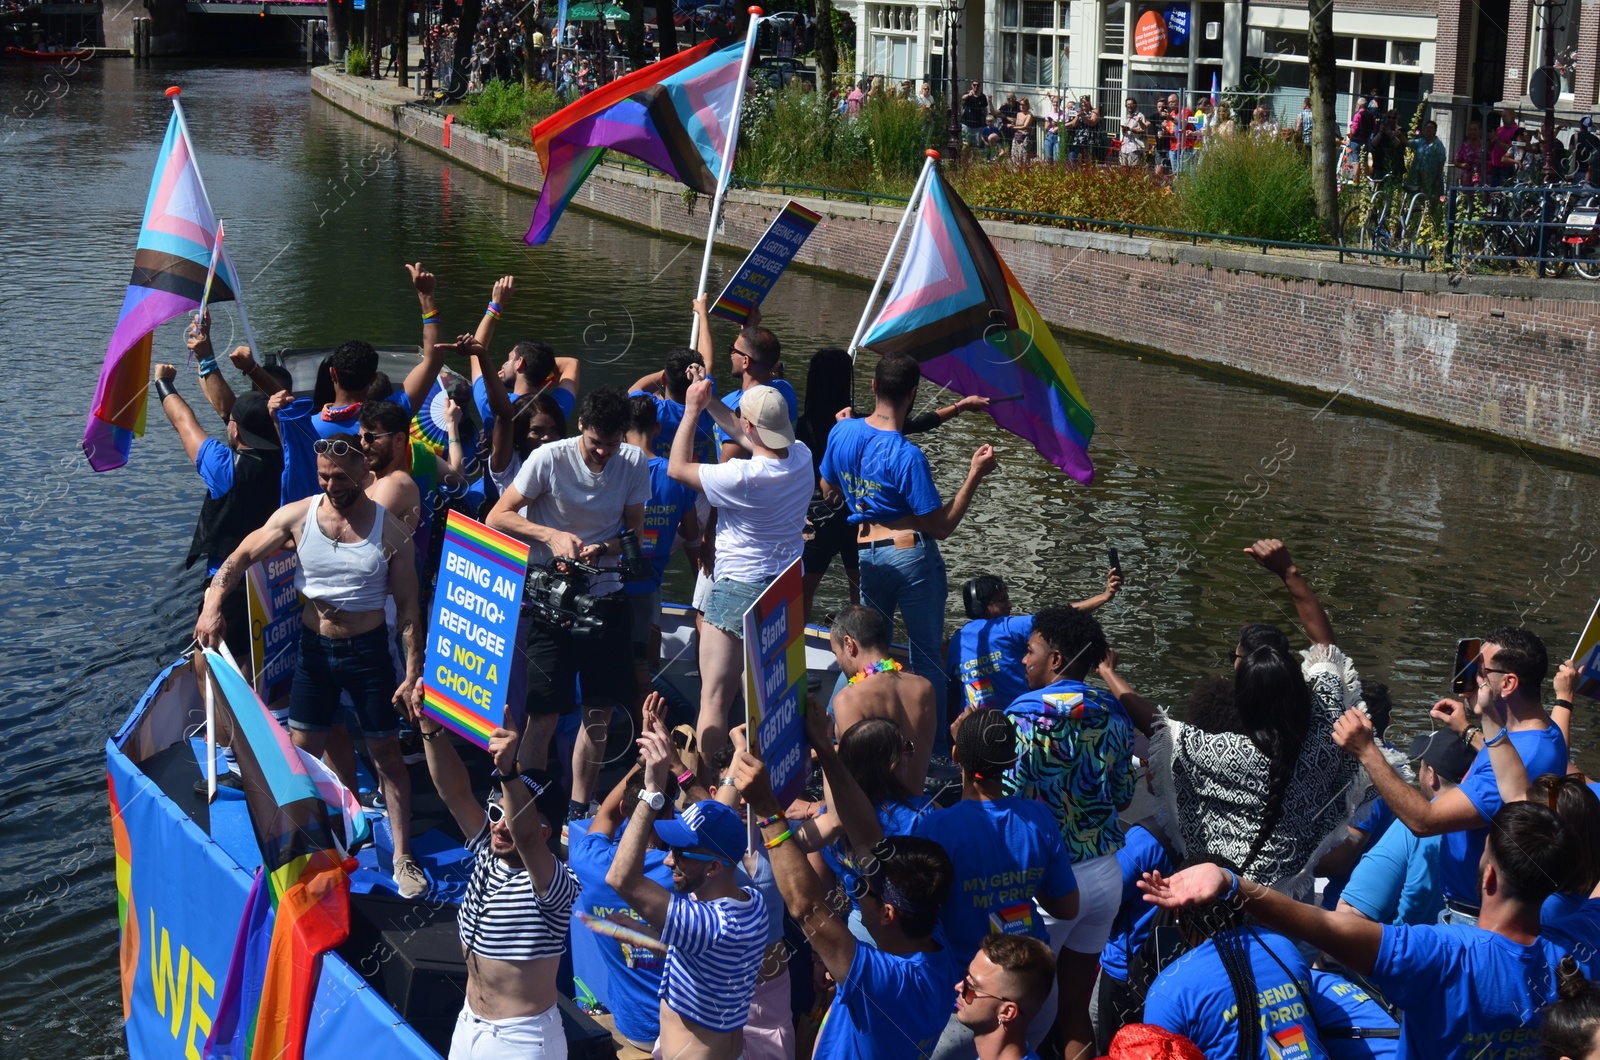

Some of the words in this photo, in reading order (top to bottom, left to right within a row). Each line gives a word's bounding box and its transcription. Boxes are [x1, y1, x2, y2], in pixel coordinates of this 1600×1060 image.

[1168, 22, 1186, 34] Service
[1170, 14, 1186, 26] Rental
[771, 224, 794, 238] BEING
[791, 232, 805, 245] AN
[740, 268, 751, 280] IS
[749, 272, 763, 286] NOT
[750, 254, 783, 274] REFUGEE
[731, 285, 760, 302] CHOICE
[644, 504, 677, 514] ENDER
[268, 552, 298, 580] Stand
[446, 551, 491, 588] BEING
[492, 576, 516, 602] AN
[274, 584, 297, 610] with
[446, 581, 506, 624] LGBTIQ+
[438, 606, 506, 658] REFUGEE
[762, 606, 786, 654] Stand
[436, 635, 452, 658] IS
[453, 644, 486, 675] NOT
[486, 664, 498, 684] A
[964, 650, 1002, 670] GENDER
[436, 666, 492, 710] CHOICE
[766, 659, 786, 698] with
[770, 742, 800, 791] fugees
[964, 878, 987, 892] MY
[973, 892, 995, 908] MY
[150, 906, 215, 1060] WE
